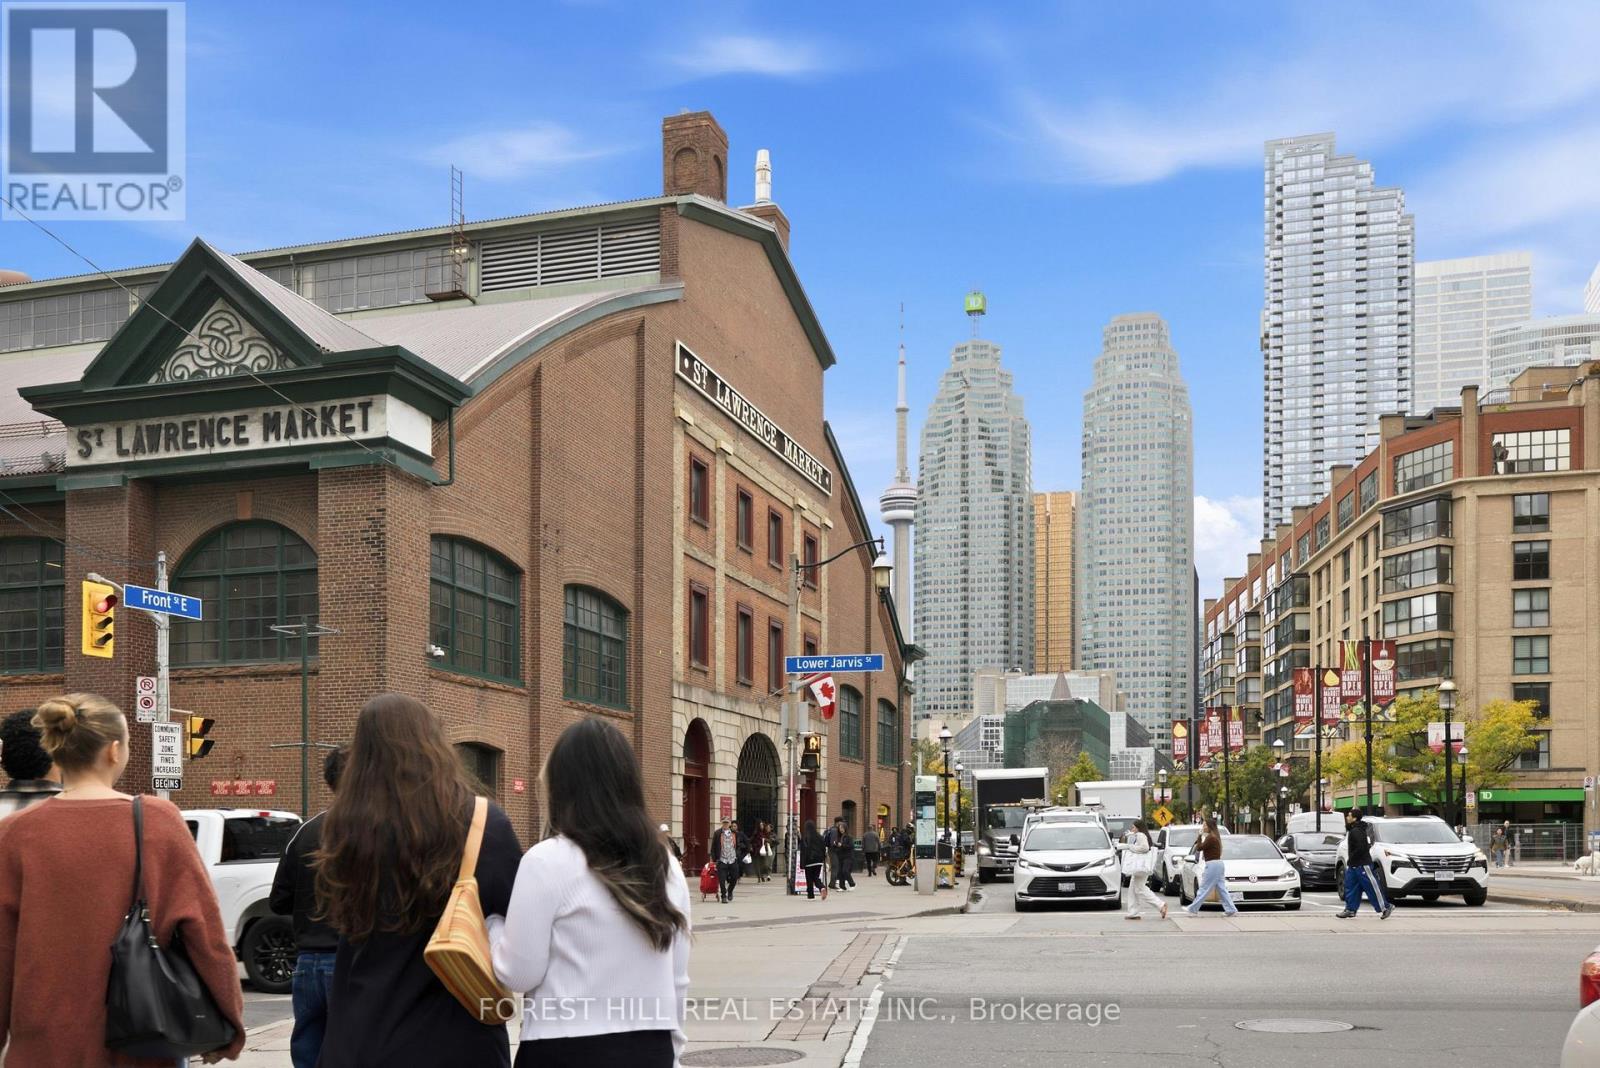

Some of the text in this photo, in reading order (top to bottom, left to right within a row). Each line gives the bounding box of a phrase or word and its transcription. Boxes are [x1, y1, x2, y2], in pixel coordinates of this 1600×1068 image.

[116, 414, 249, 456] LAWRENCE
[263, 401, 373, 442] MARKET
[716, 379, 777, 448] LAWRENCE
[783, 436, 823, 484] MARKET
[142, 590, 171, 609] Front
[181, 598, 188, 612] E
[796, 658, 828, 669] Lower
[830, 656, 863, 668] Jarvis
[155, 725, 180, 734] COMMUNITY
[159, 735, 176, 743] SAFETY
[161, 745, 174, 753] ZONE
[160, 756, 174, 764] FINES
[155, 766, 181, 774] INCREASED
[155, 779, 179, 789] BEGINS
[1480, 791, 1492, 800] TD
